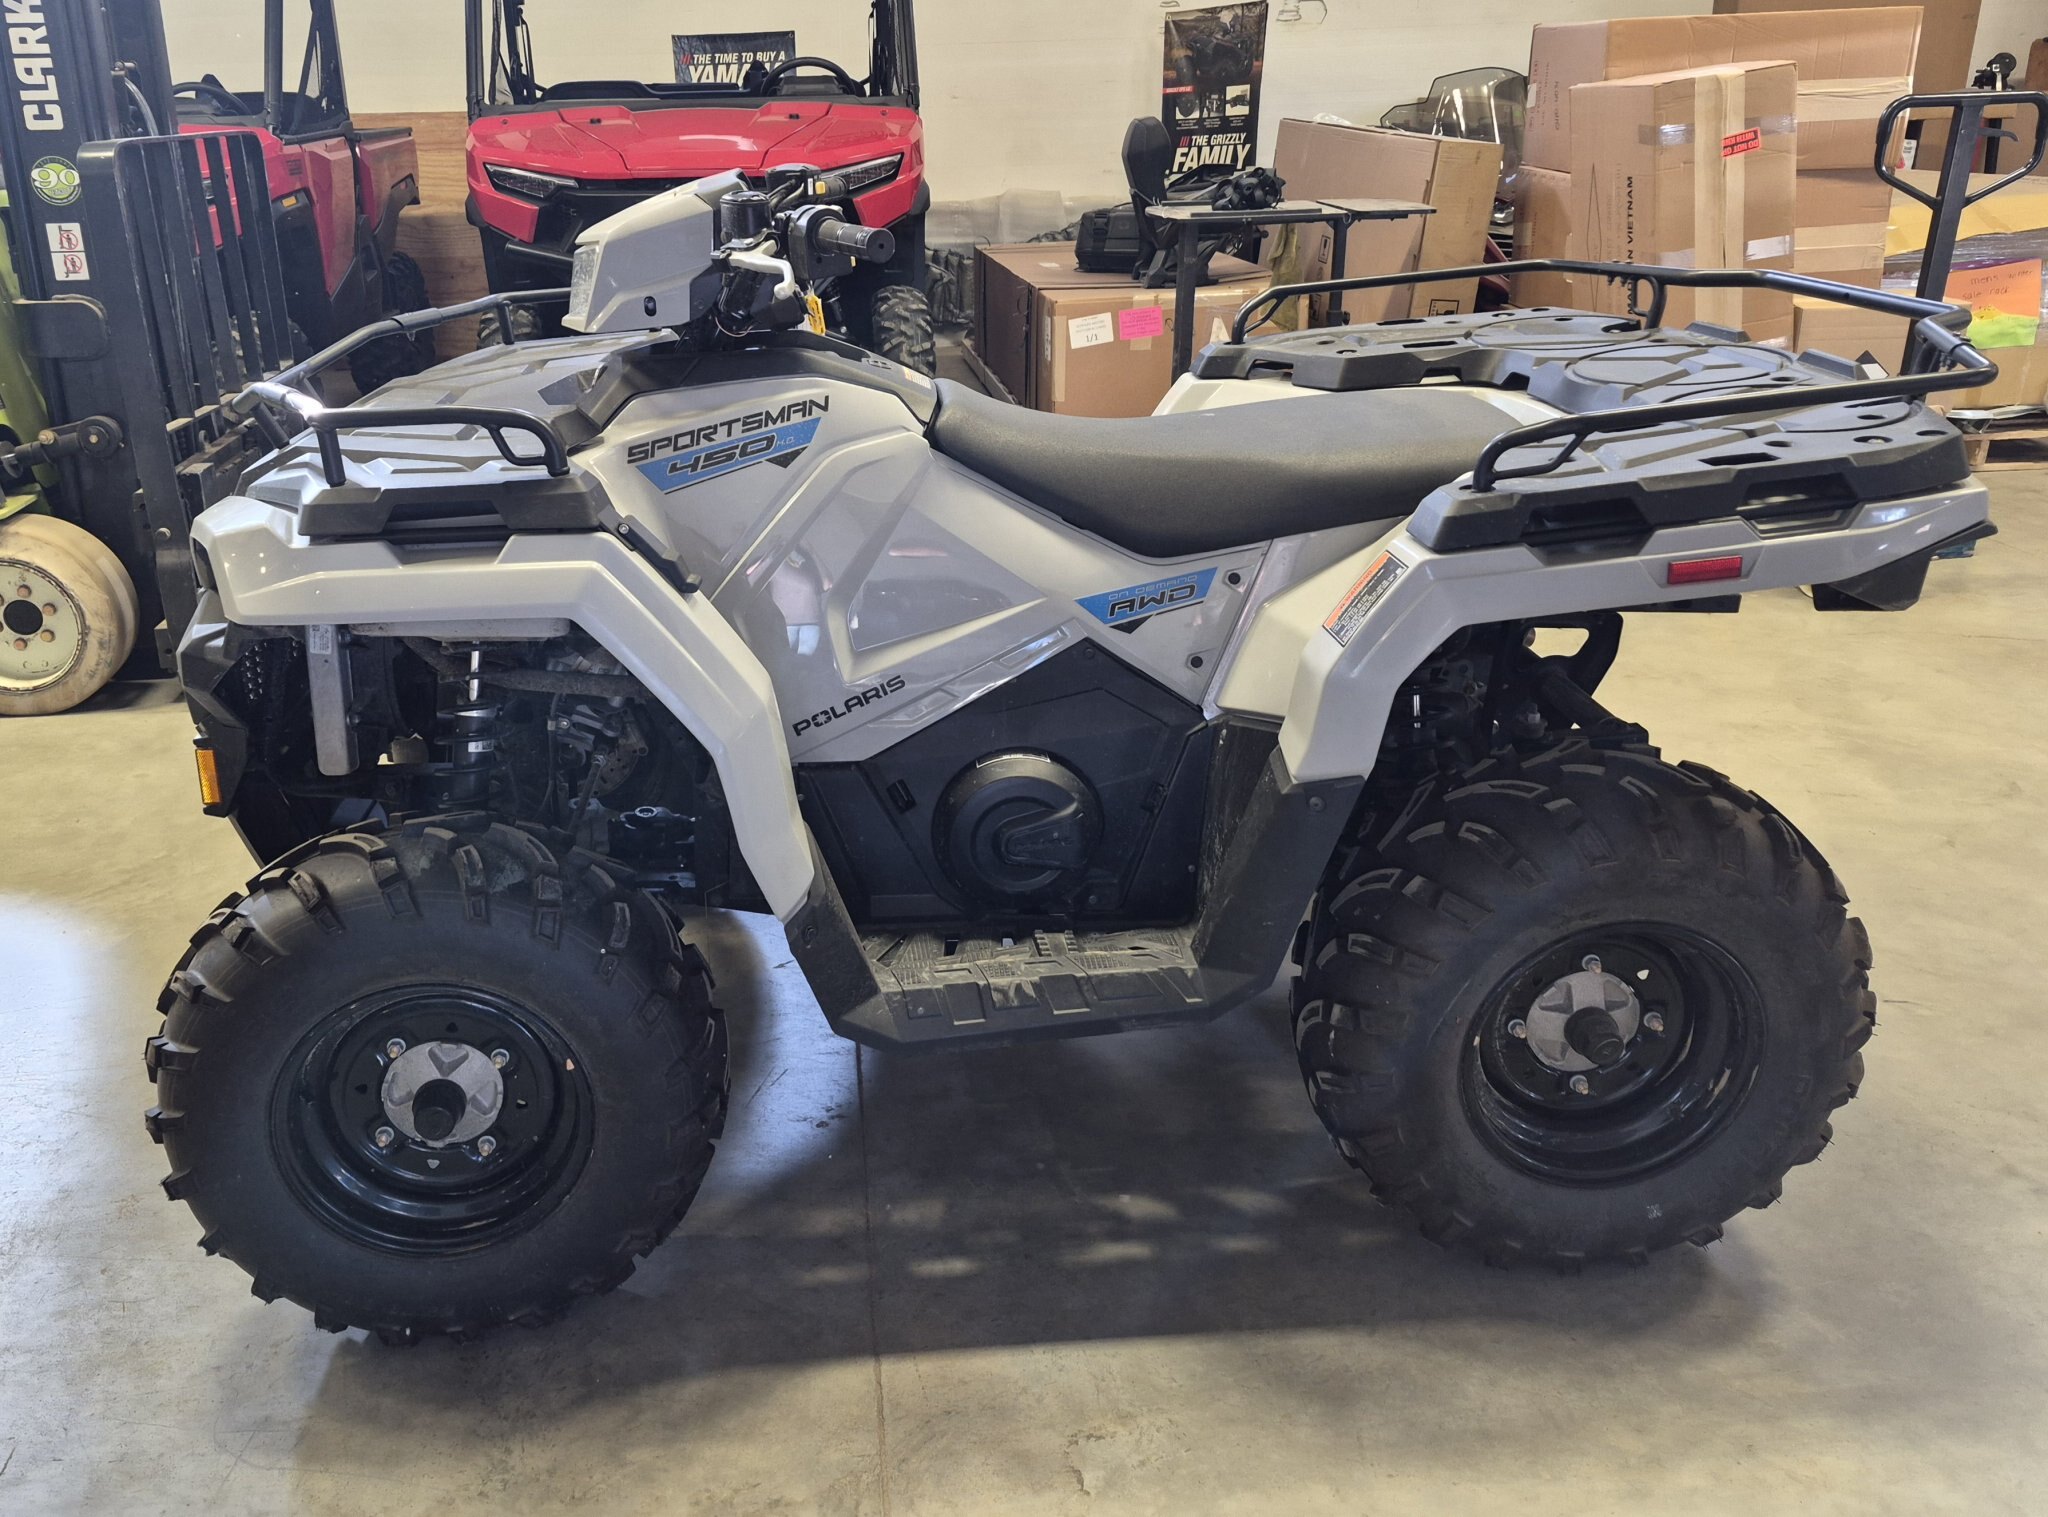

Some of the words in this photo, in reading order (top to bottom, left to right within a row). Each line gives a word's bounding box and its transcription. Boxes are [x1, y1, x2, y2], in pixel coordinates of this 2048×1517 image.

[3, 0, 64, 131] CLARK
[692, 53, 712, 65] THE
[714, 52, 739, 64] TIME
[741, 51, 754, 63] TO
[756, 51, 777, 61] BUY
[778, 51, 785, 61] A
[1191, 134, 1209, 146] THE
[1210, 132, 1247, 145] GRIZZLY
[31, 168, 80, 189] 90
[627, 395, 830, 464] SPORTSMAN
[667, 432, 777, 476] 450
[1107, 583, 1197, 618] AWD
[1108, 589, 1129, 601] ON
[1135, 574, 1198, 594] DEMAND
[792, 674, 906, 737] POLARIS
